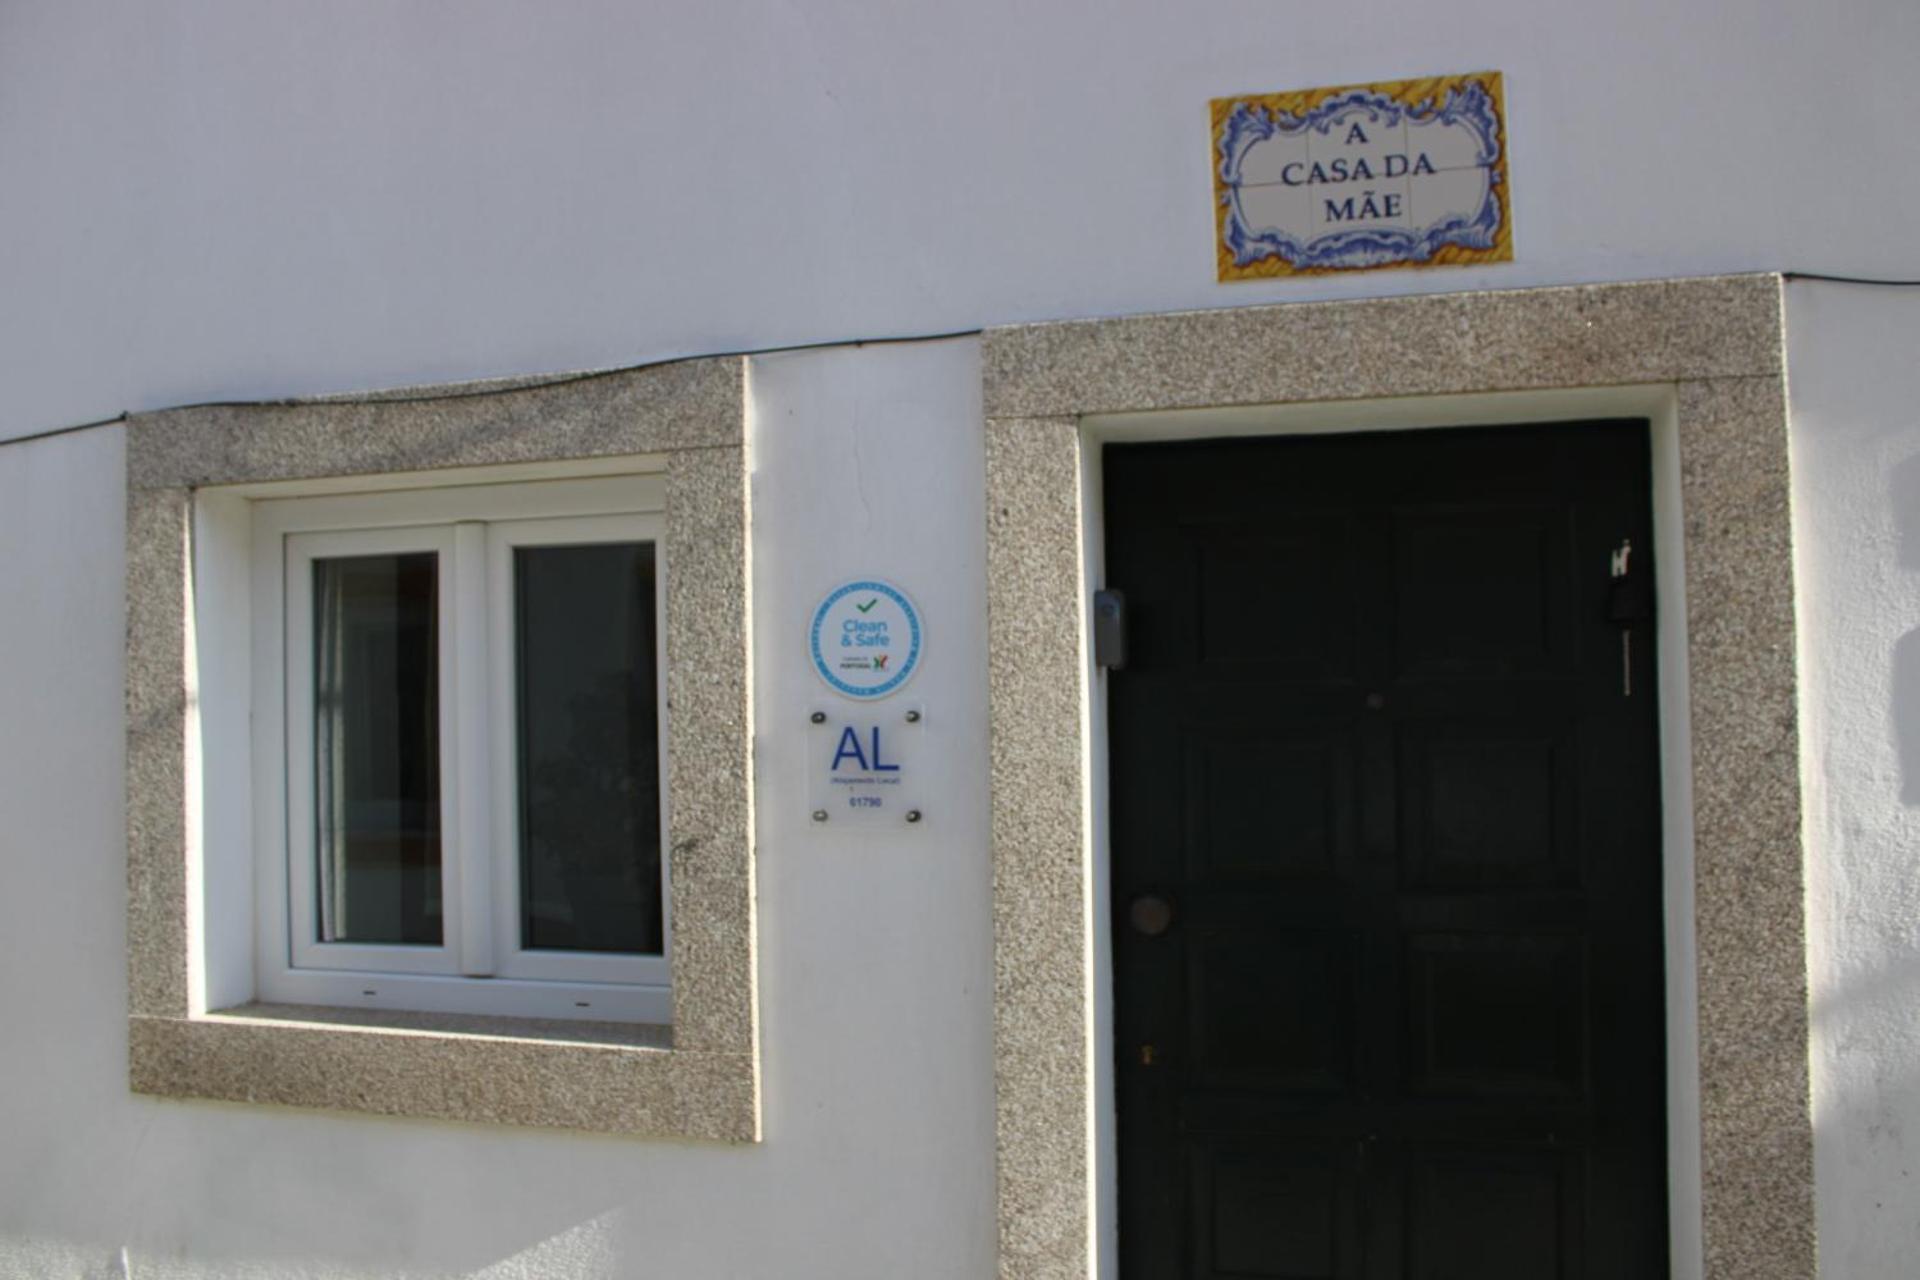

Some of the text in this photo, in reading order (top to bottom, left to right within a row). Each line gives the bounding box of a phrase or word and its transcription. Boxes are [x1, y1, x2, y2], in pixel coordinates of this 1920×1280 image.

[1345, 122, 1368, 144] A
[1281, 153, 1436, 186] CASA DA
[1324, 191, 1402, 222] MÃE
[843, 620, 888, 632] Clean
[841, 633, 890, 646] & Safe
[831, 726, 899, 771] AL
